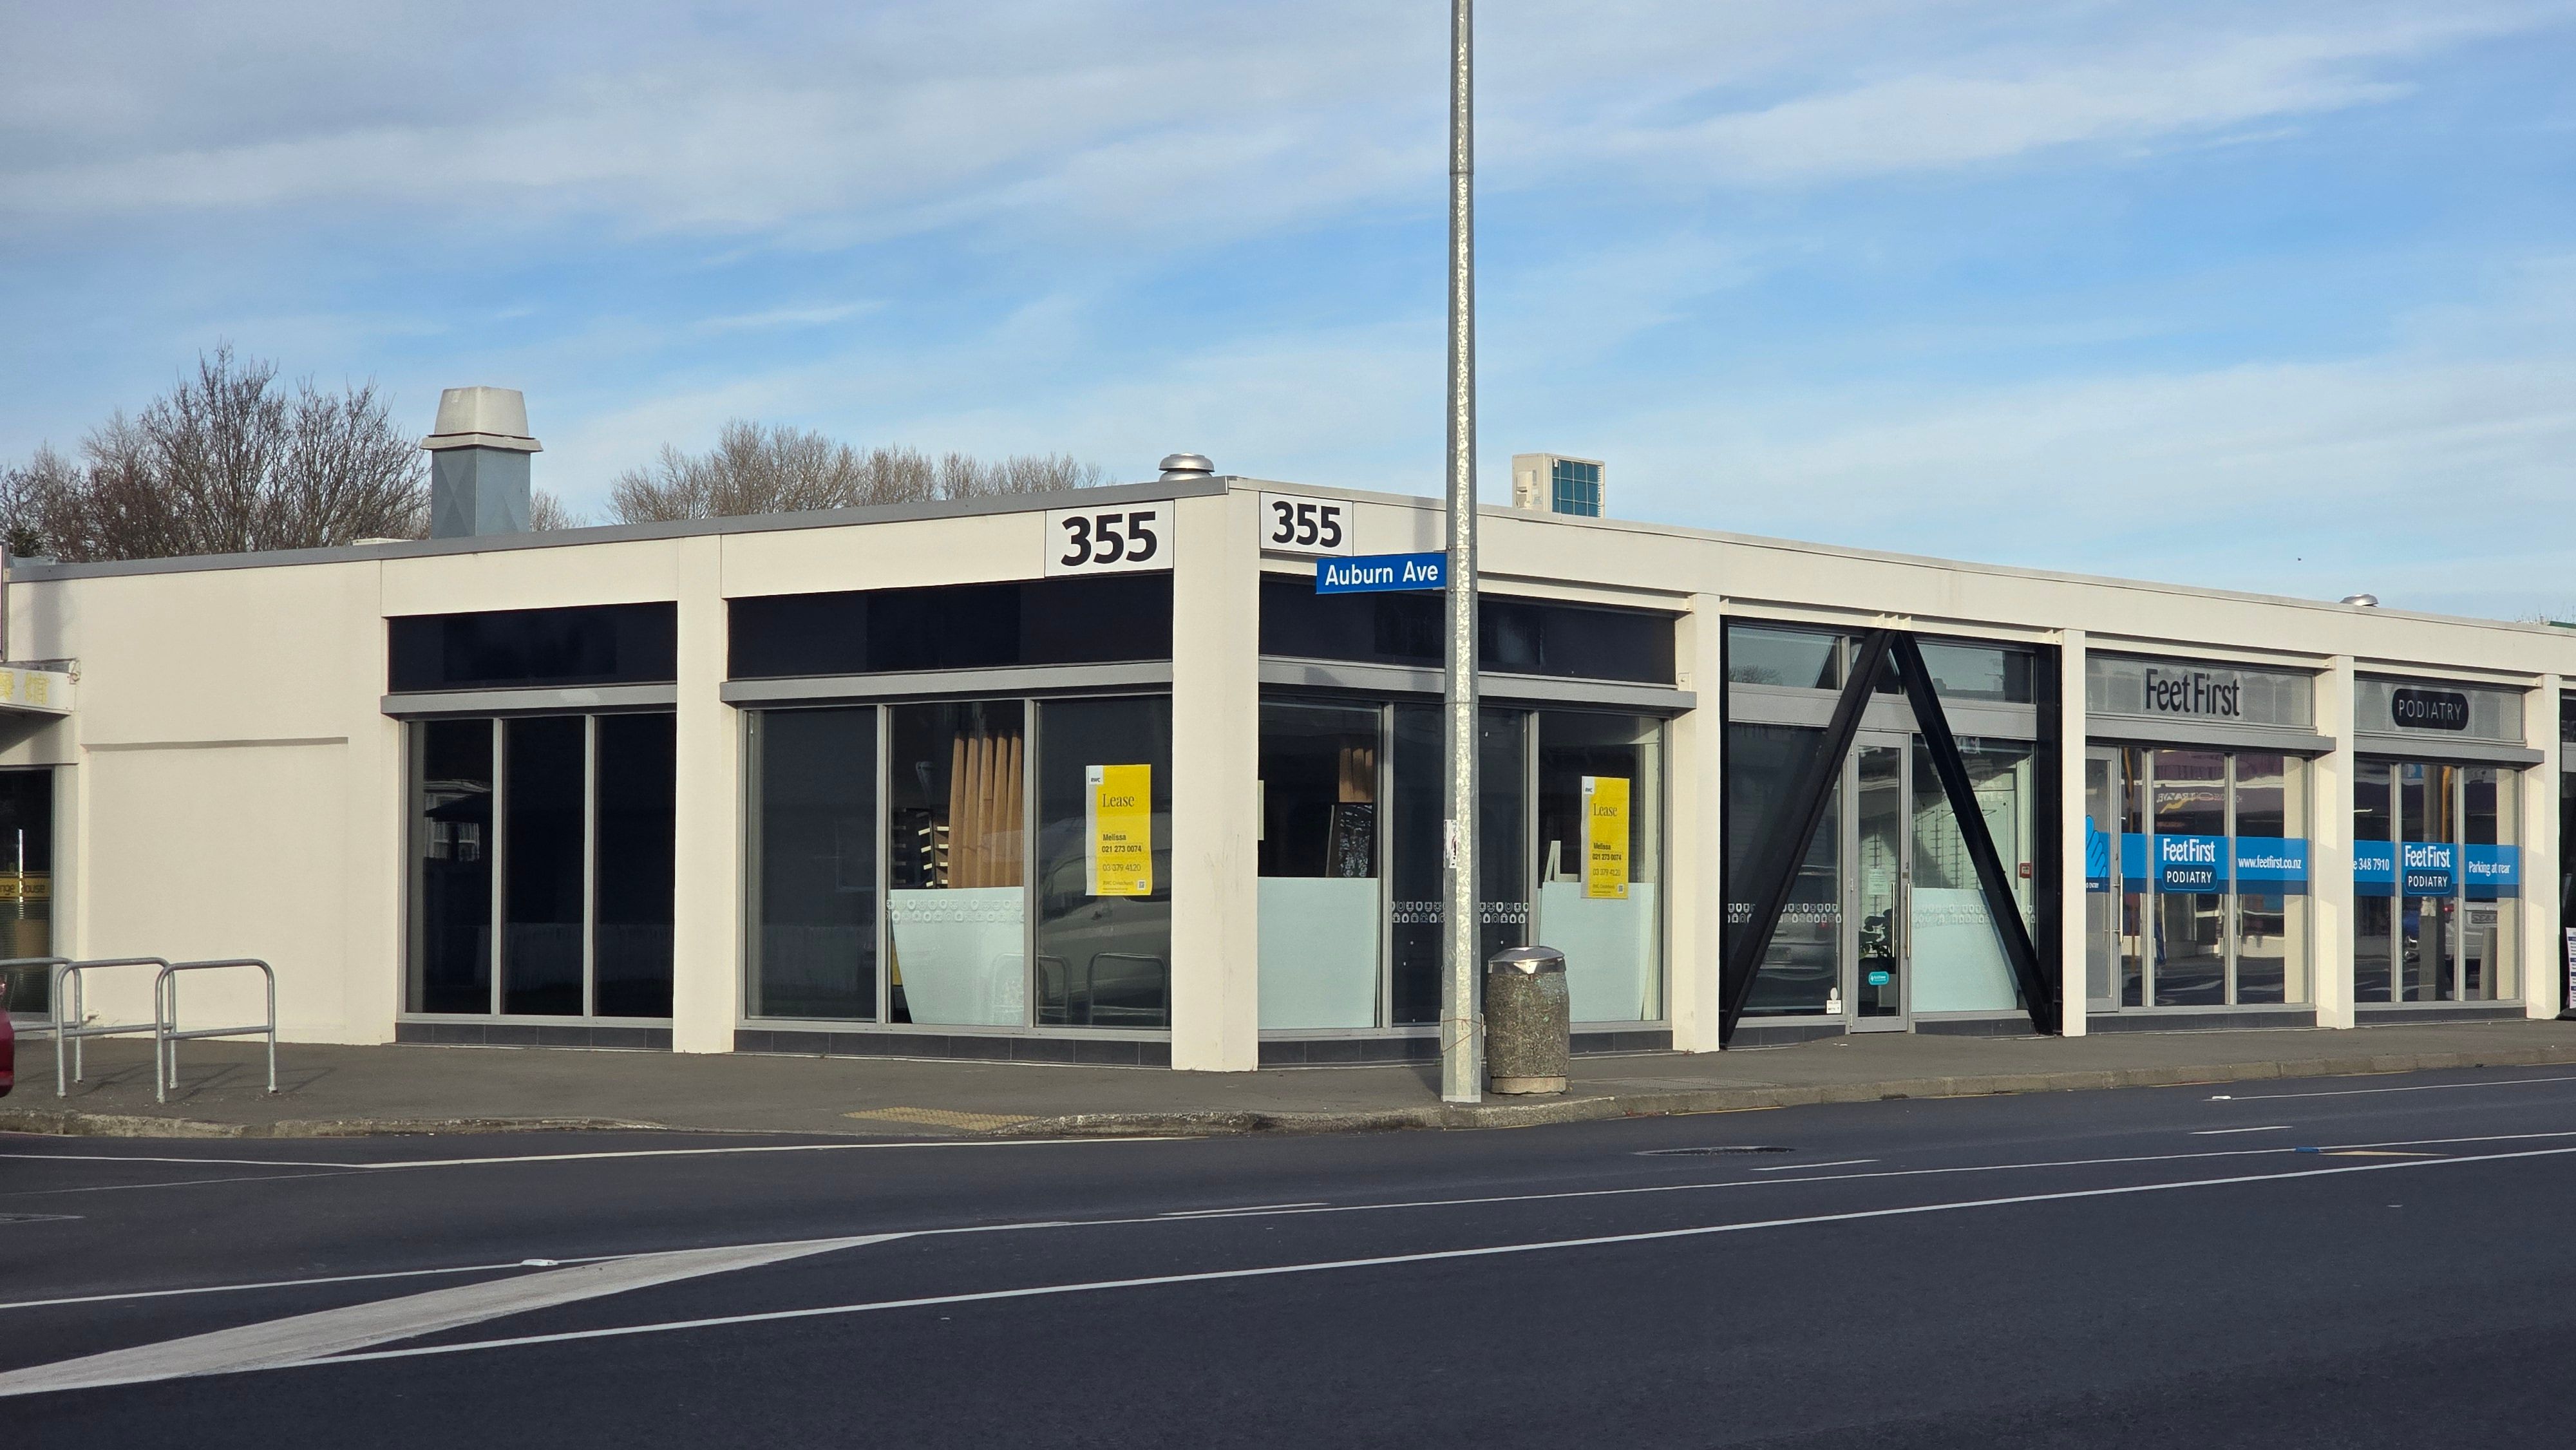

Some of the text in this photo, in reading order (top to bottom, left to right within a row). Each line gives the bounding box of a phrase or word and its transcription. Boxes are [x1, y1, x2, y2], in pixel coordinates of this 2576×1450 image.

[1271, 501, 1342, 548] 355
[1060, 511, 1157, 567] 355
[1325, 561, 1439, 586] Auburn Ave
[2399, 699, 2462, 720] PODIATRY
[1103, 793, 1135, 807] Lease
[1593, 804, 1617, 816] Lease
[2238, 855, 2302, 869] www.feetfirst.co.nz
[2358, 858, 2372, 871] 348
[2372, 858, 2390, 871] 7910
[2468, 861, 2511, 877] Parking at rear
[2166, 871, 2212, 883] PODIATRY
[2409, 876, 2448, 887] PODIATRY
